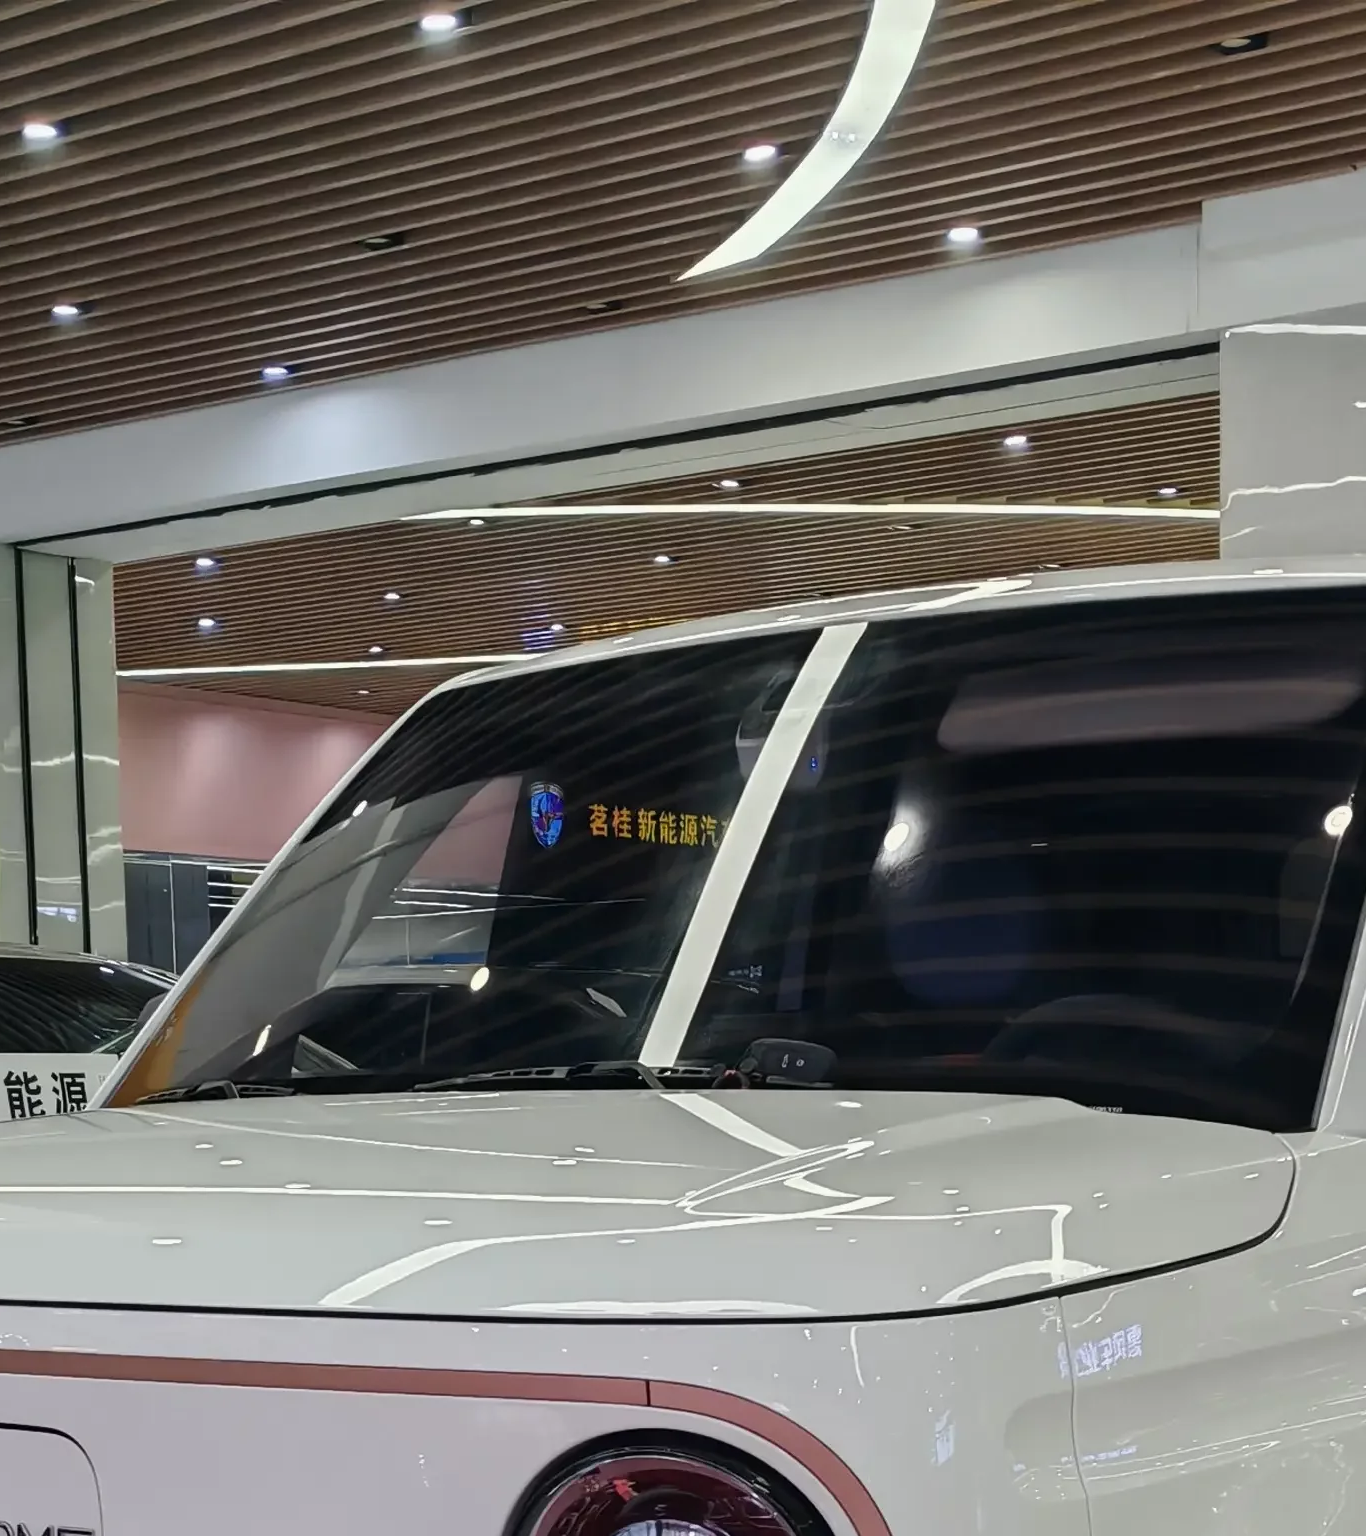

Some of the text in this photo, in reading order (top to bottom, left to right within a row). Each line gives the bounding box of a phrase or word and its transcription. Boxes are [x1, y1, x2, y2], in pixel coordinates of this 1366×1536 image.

[588, 803, 731, 849] 茗桂新能源汽
